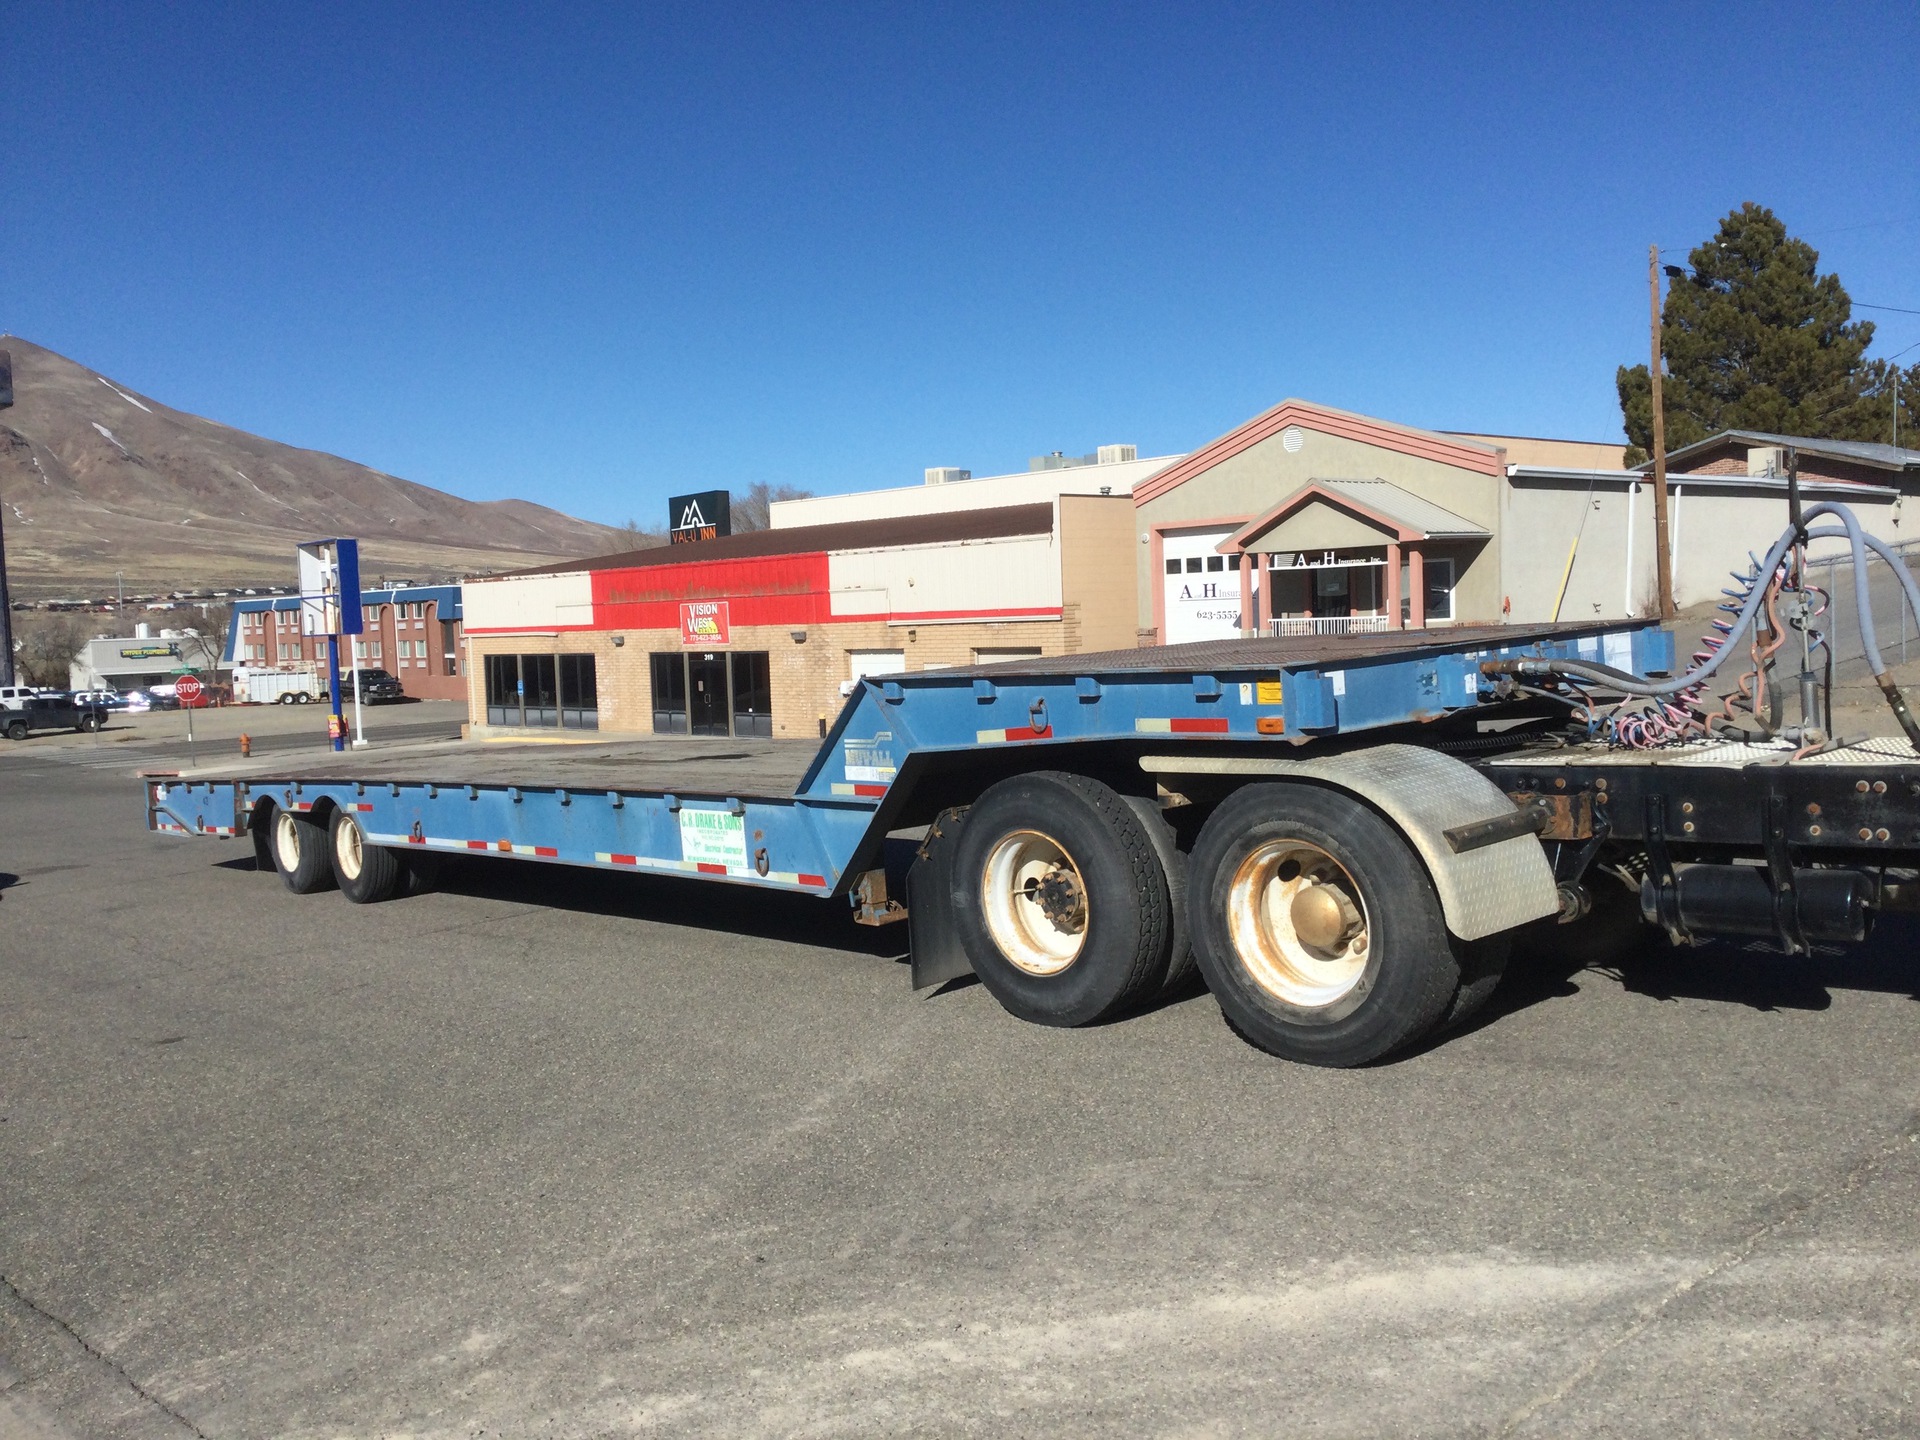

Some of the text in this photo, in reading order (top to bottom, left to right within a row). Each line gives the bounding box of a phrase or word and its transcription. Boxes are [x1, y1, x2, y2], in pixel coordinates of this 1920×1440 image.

[672, 526, 716, 543] VAL-U INN
[1296, 553, 1308, 567] A
[1323, 551, 1335, 566] H
[1339, 557, 1366, 565] Insurance
[1179, 584, 1193, 599] A
[1203, 583, 1217, 598] H
[689, 604, 718, 619] VISION
[1196, 610, 1238, 620] 623-5555
[687, 617, 713, 633] WEST
[176, 683, 199, 694] STOP
[695, 814, 717, 829] DRAKE
